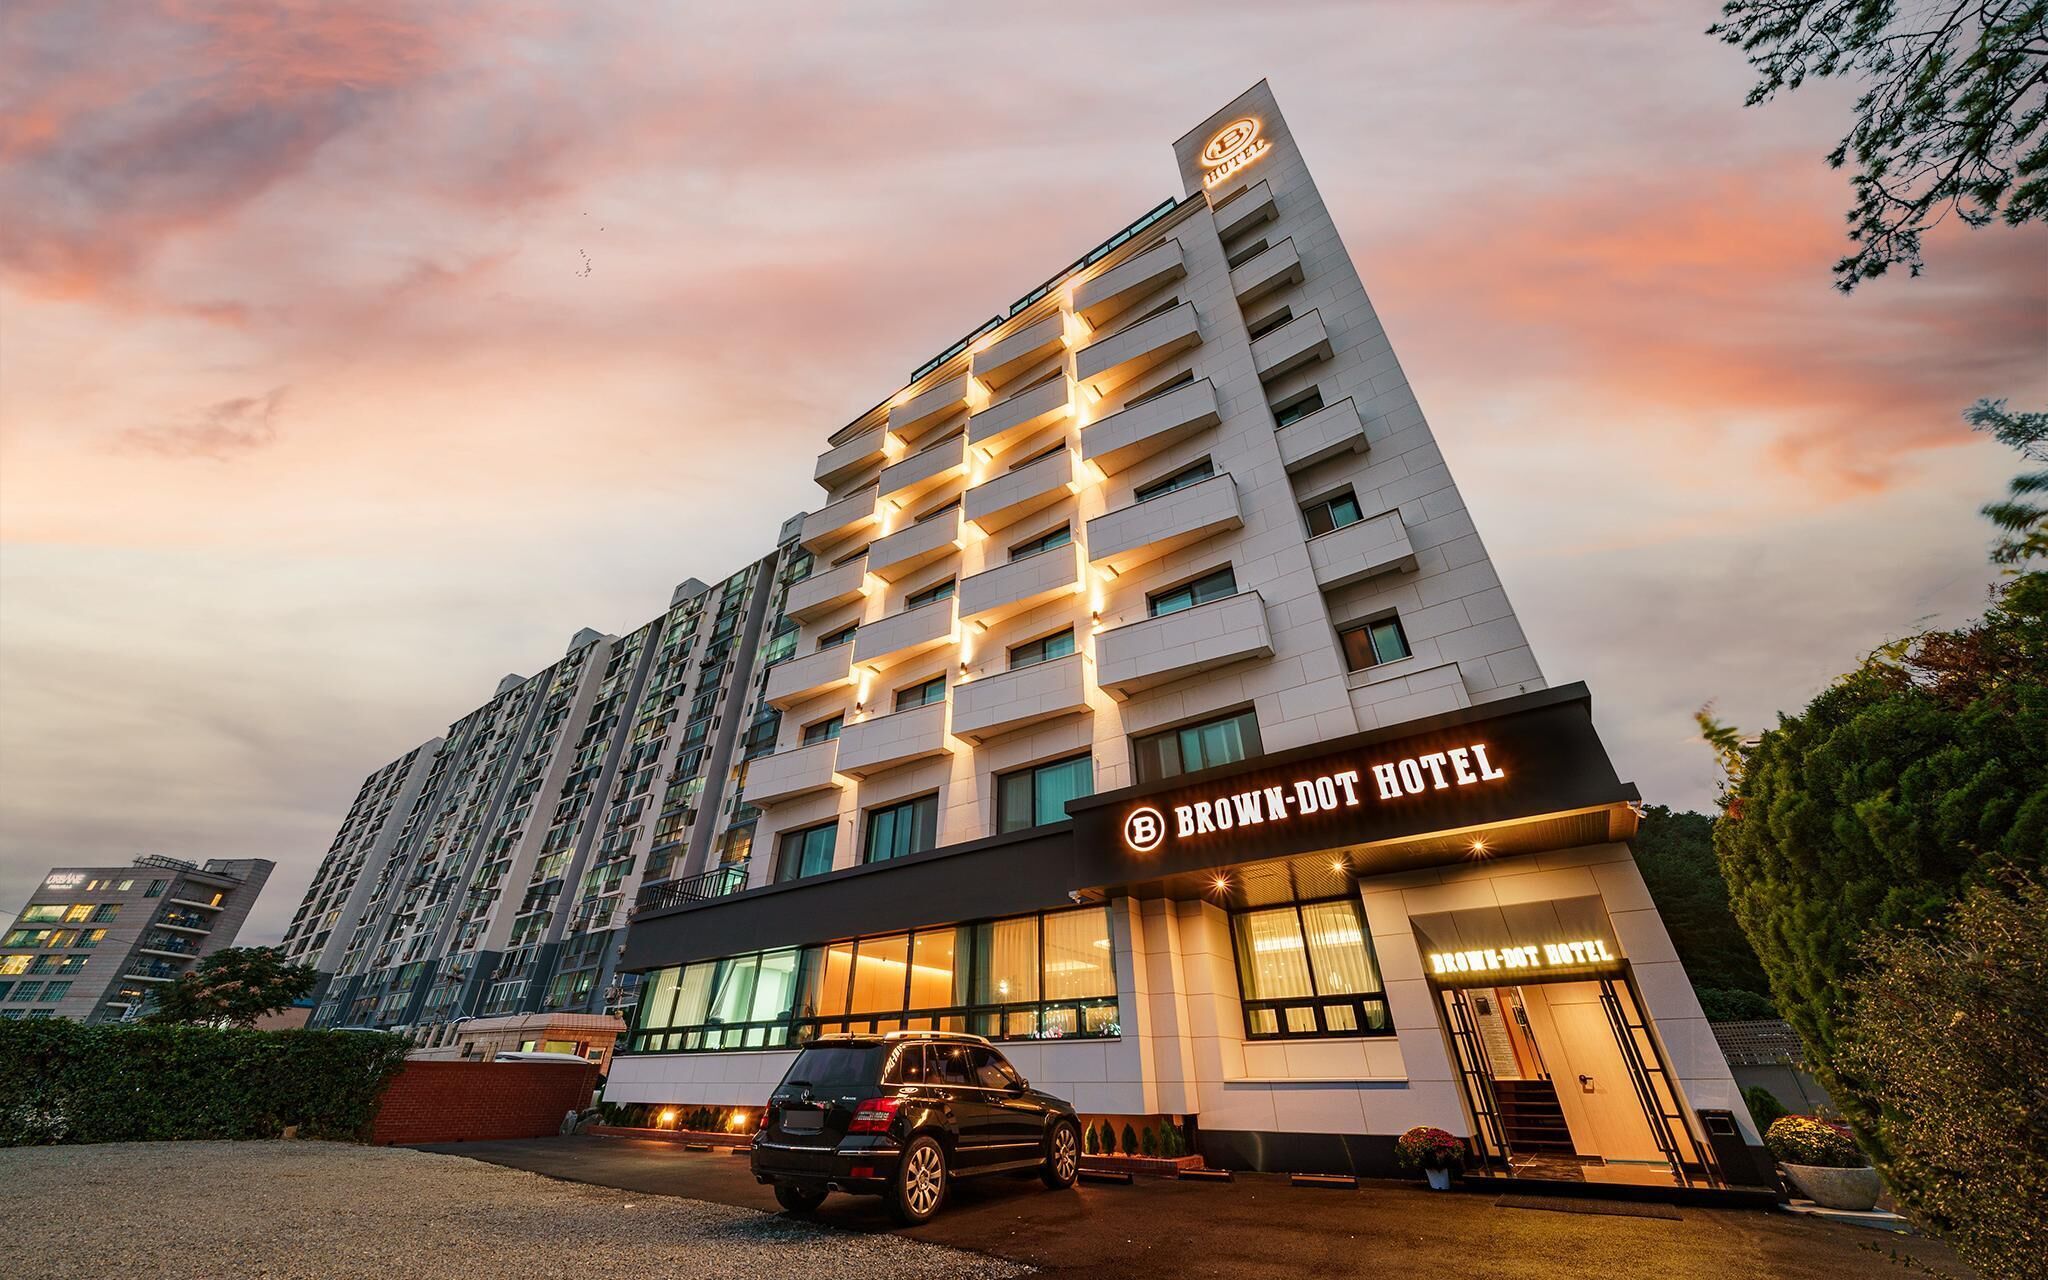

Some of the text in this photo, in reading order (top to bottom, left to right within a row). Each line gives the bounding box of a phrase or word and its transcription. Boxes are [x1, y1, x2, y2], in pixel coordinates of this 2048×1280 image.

[1207, 140, 1266, 183] HOTEL
[1174, 770, 1359, 838] BROWN-DOT
[1372, 743, 1504, 800] HOTEL
[1430, 939, 1614, 974] BROWN-DOT HOTEL
